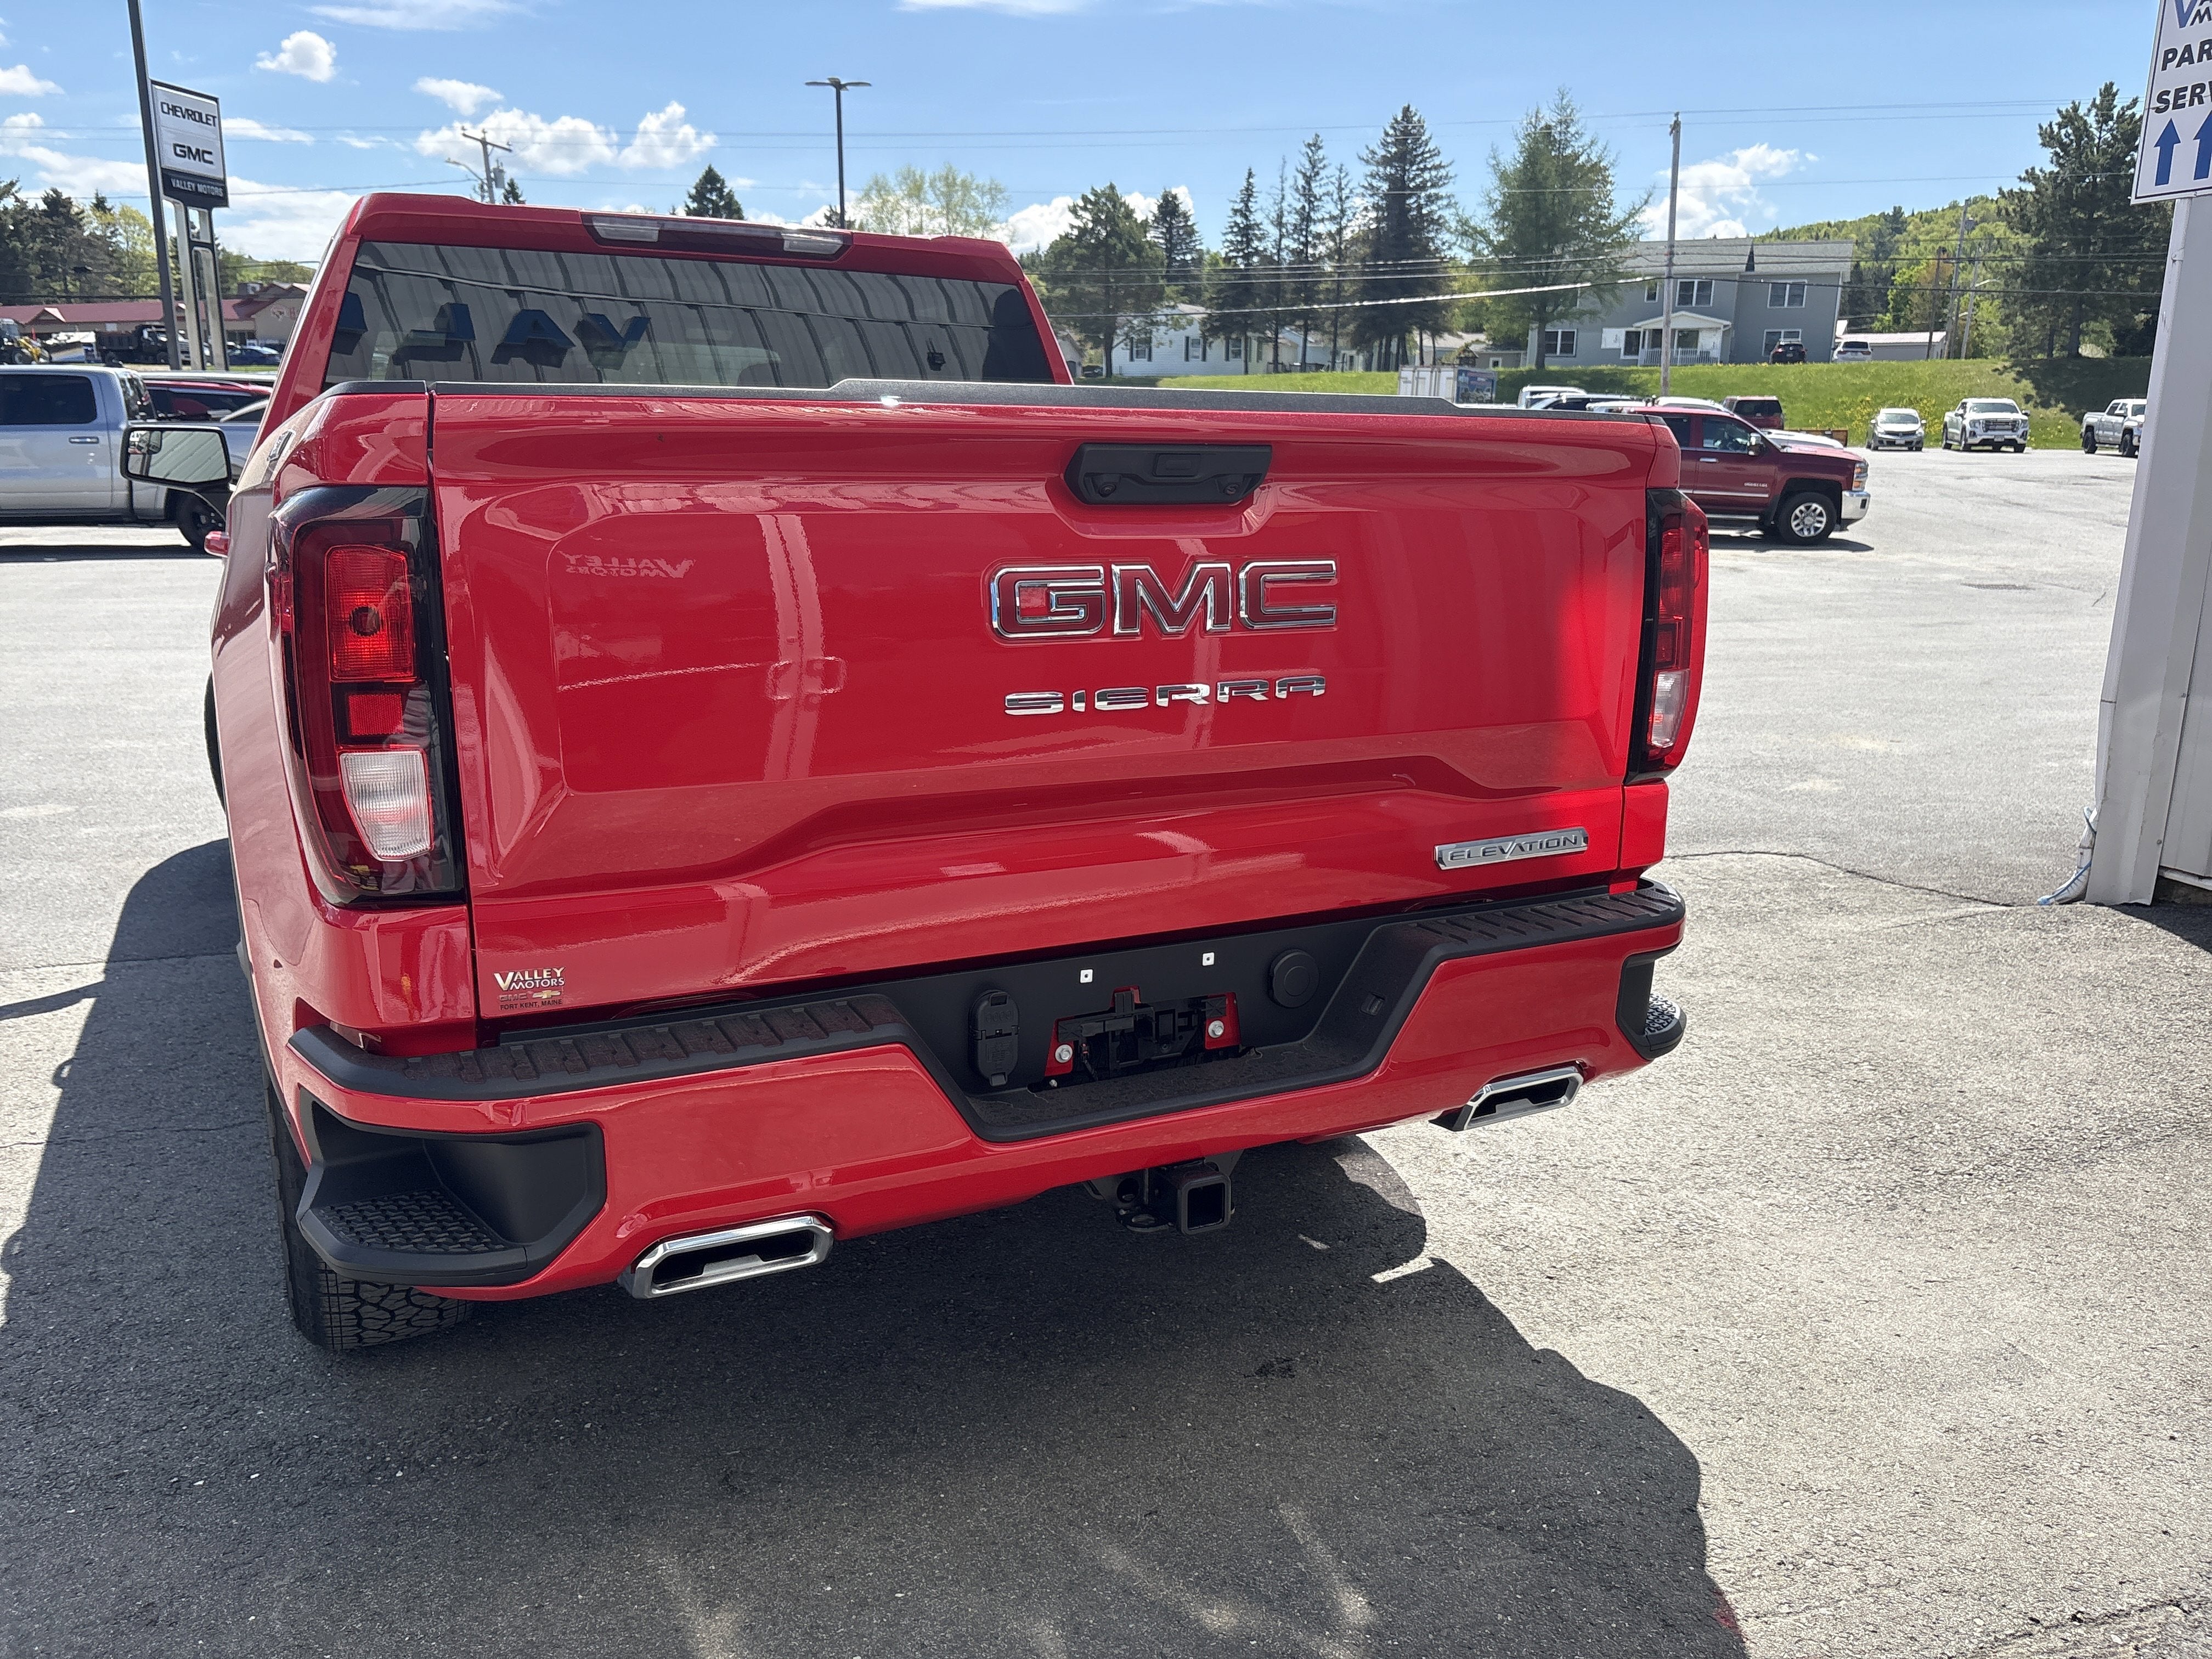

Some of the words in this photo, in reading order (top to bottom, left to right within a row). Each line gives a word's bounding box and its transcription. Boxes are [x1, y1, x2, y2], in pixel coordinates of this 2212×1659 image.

[2154, 81, 2212, 114] SER
[161, 102, 217, 127] CHEVROLET
[173, 143, 213, 164] GMC
[171, 178, 196, 191] VALLEY
[197, 183, 224, 198] MOTORS
[989, 560, 1338, 639] GMC
[1004, 675, 1327, 715] SIERRA
[1448, 834, 1578, 859] ELEVATION
[494, 966, 566, 991] VALLEY
[509, 977, 565, 991] MOTORS
[500, 993, 527, 1002] GMC
